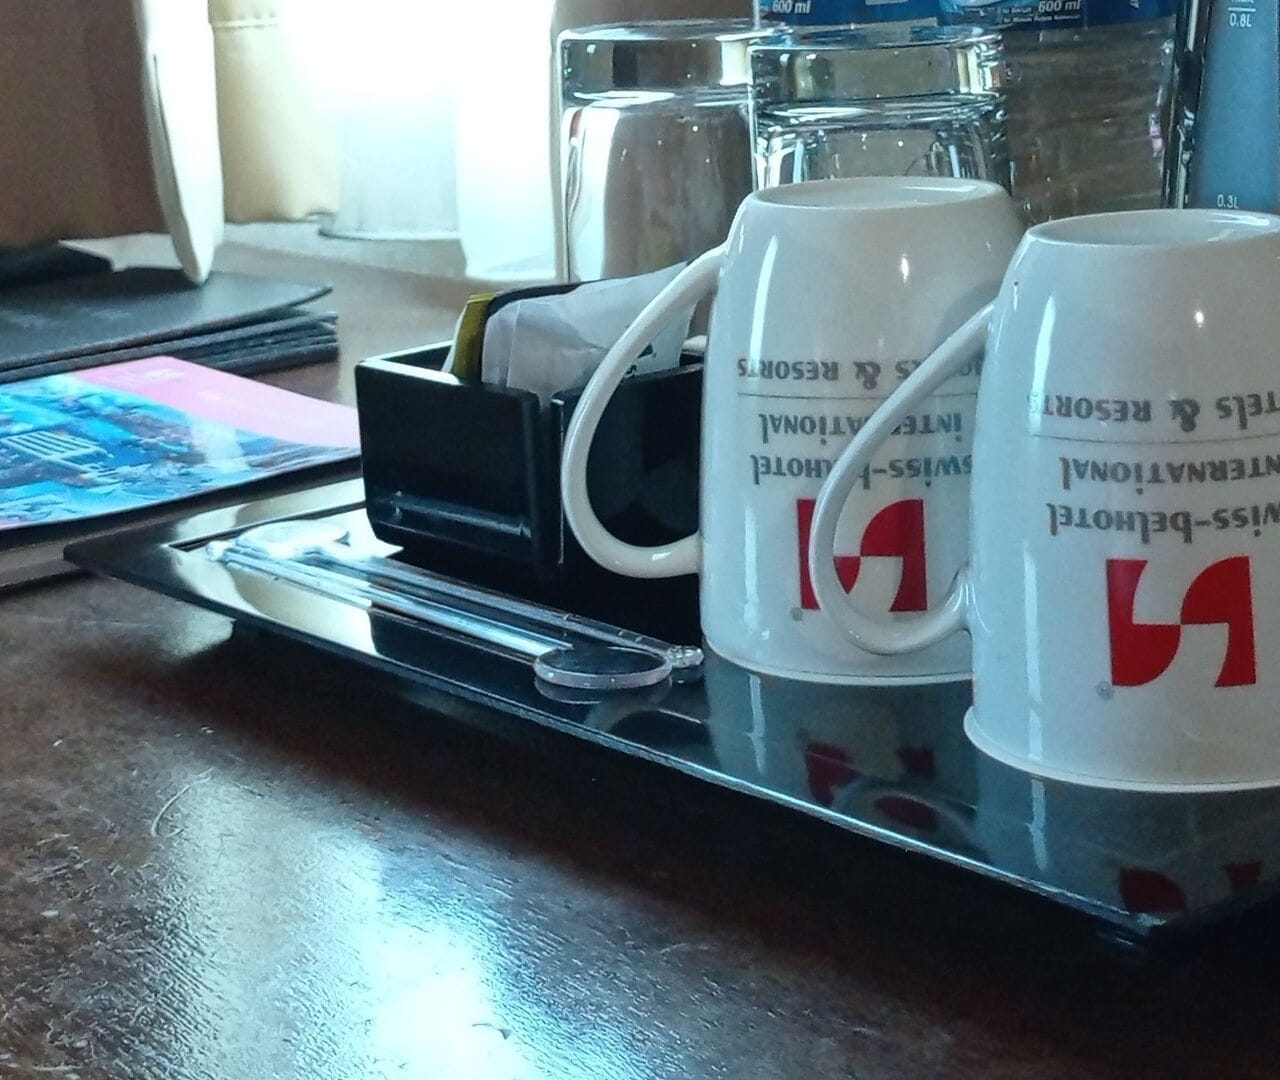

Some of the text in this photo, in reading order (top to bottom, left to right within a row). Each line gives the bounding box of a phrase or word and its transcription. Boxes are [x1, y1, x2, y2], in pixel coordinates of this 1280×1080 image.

[772, 0, 811, 13] 600 ml
[1038, 0, 1062, 13] 600
[1217, 194, 1239, 209] 0.3L
[737, 358, 839, 381] RESORTS
[853, 360, 882, 390] &
[1170, 397, 1201, 433] &
